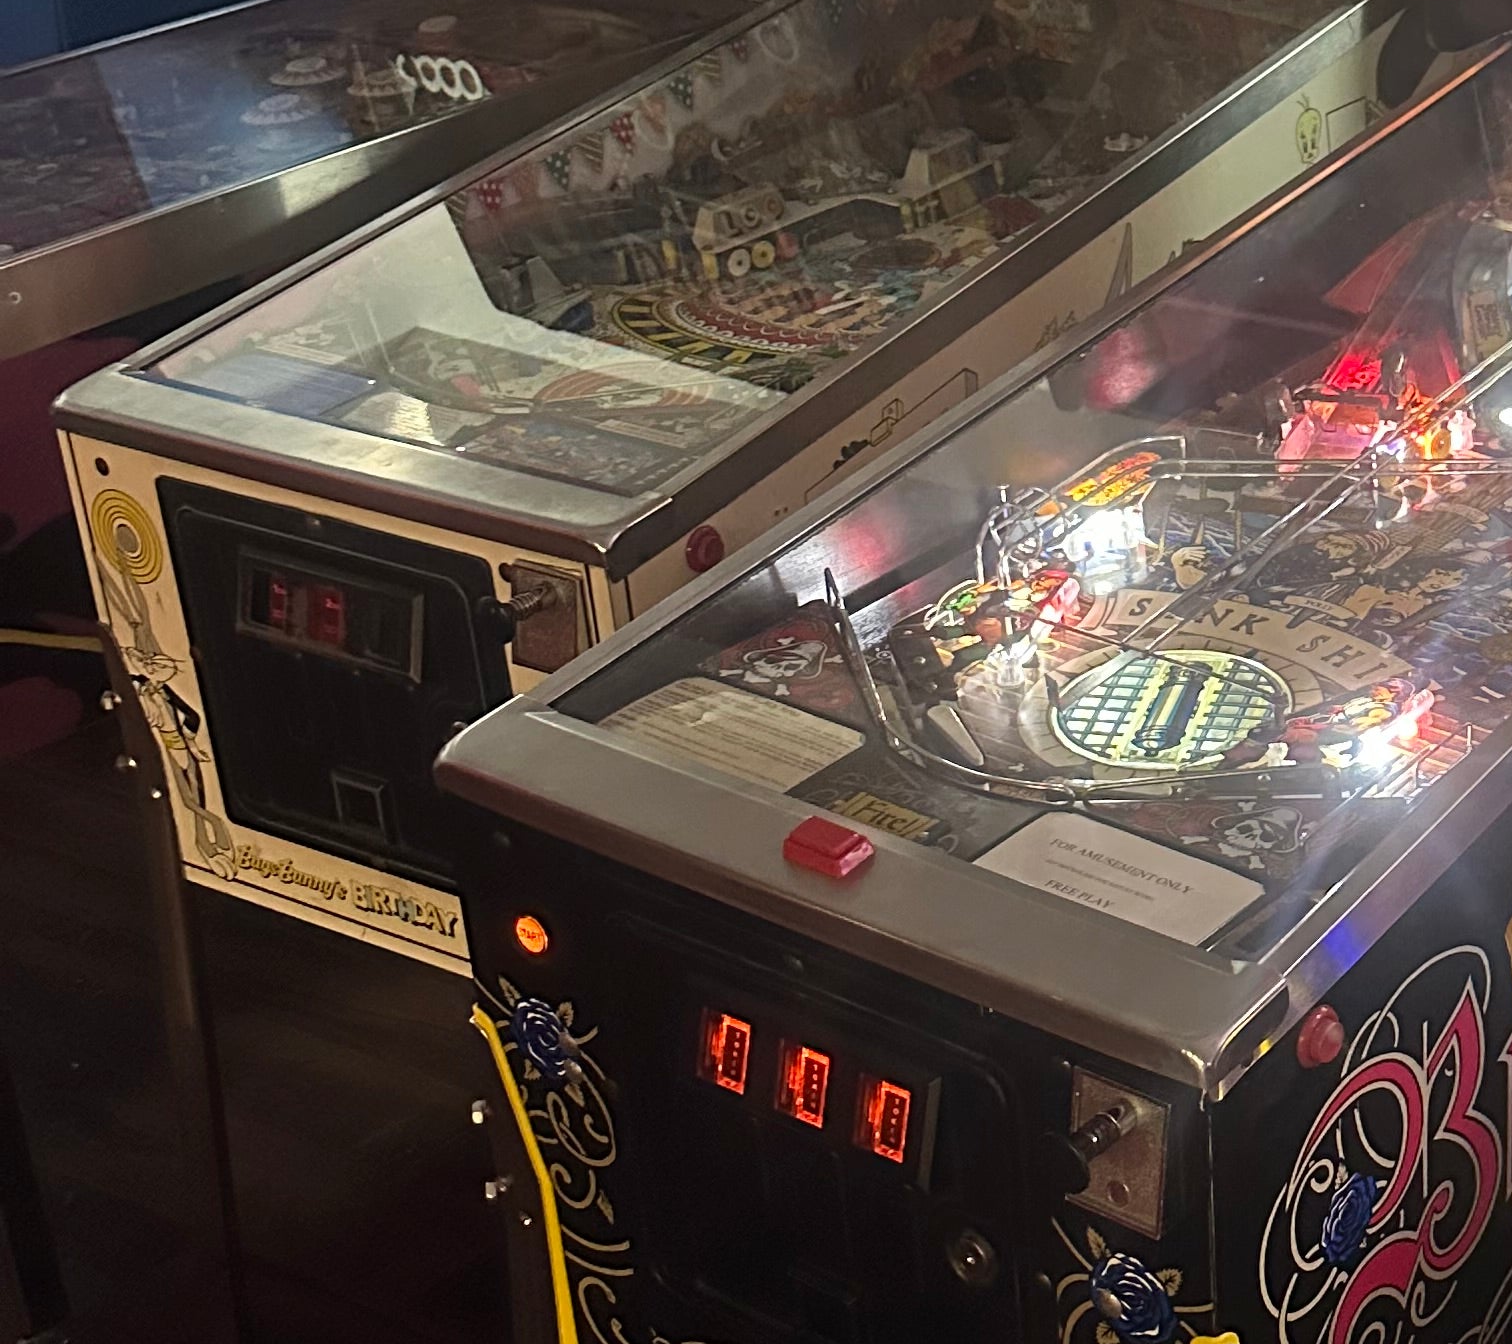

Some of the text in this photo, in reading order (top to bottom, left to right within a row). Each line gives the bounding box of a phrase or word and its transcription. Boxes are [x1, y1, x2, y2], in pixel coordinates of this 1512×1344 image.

[238, 845, 459, 939] Bugs Bunny's BIRTHDAY
[1044, 878, 1079, 899] FREE
[1080, 892, 1115, 909] PLAY
[1049, 837, 1077, 853] FOR
[1076, 848, 1158, 884] AMUSEMENT
[1156, 875, 1195, 895] ONLY
